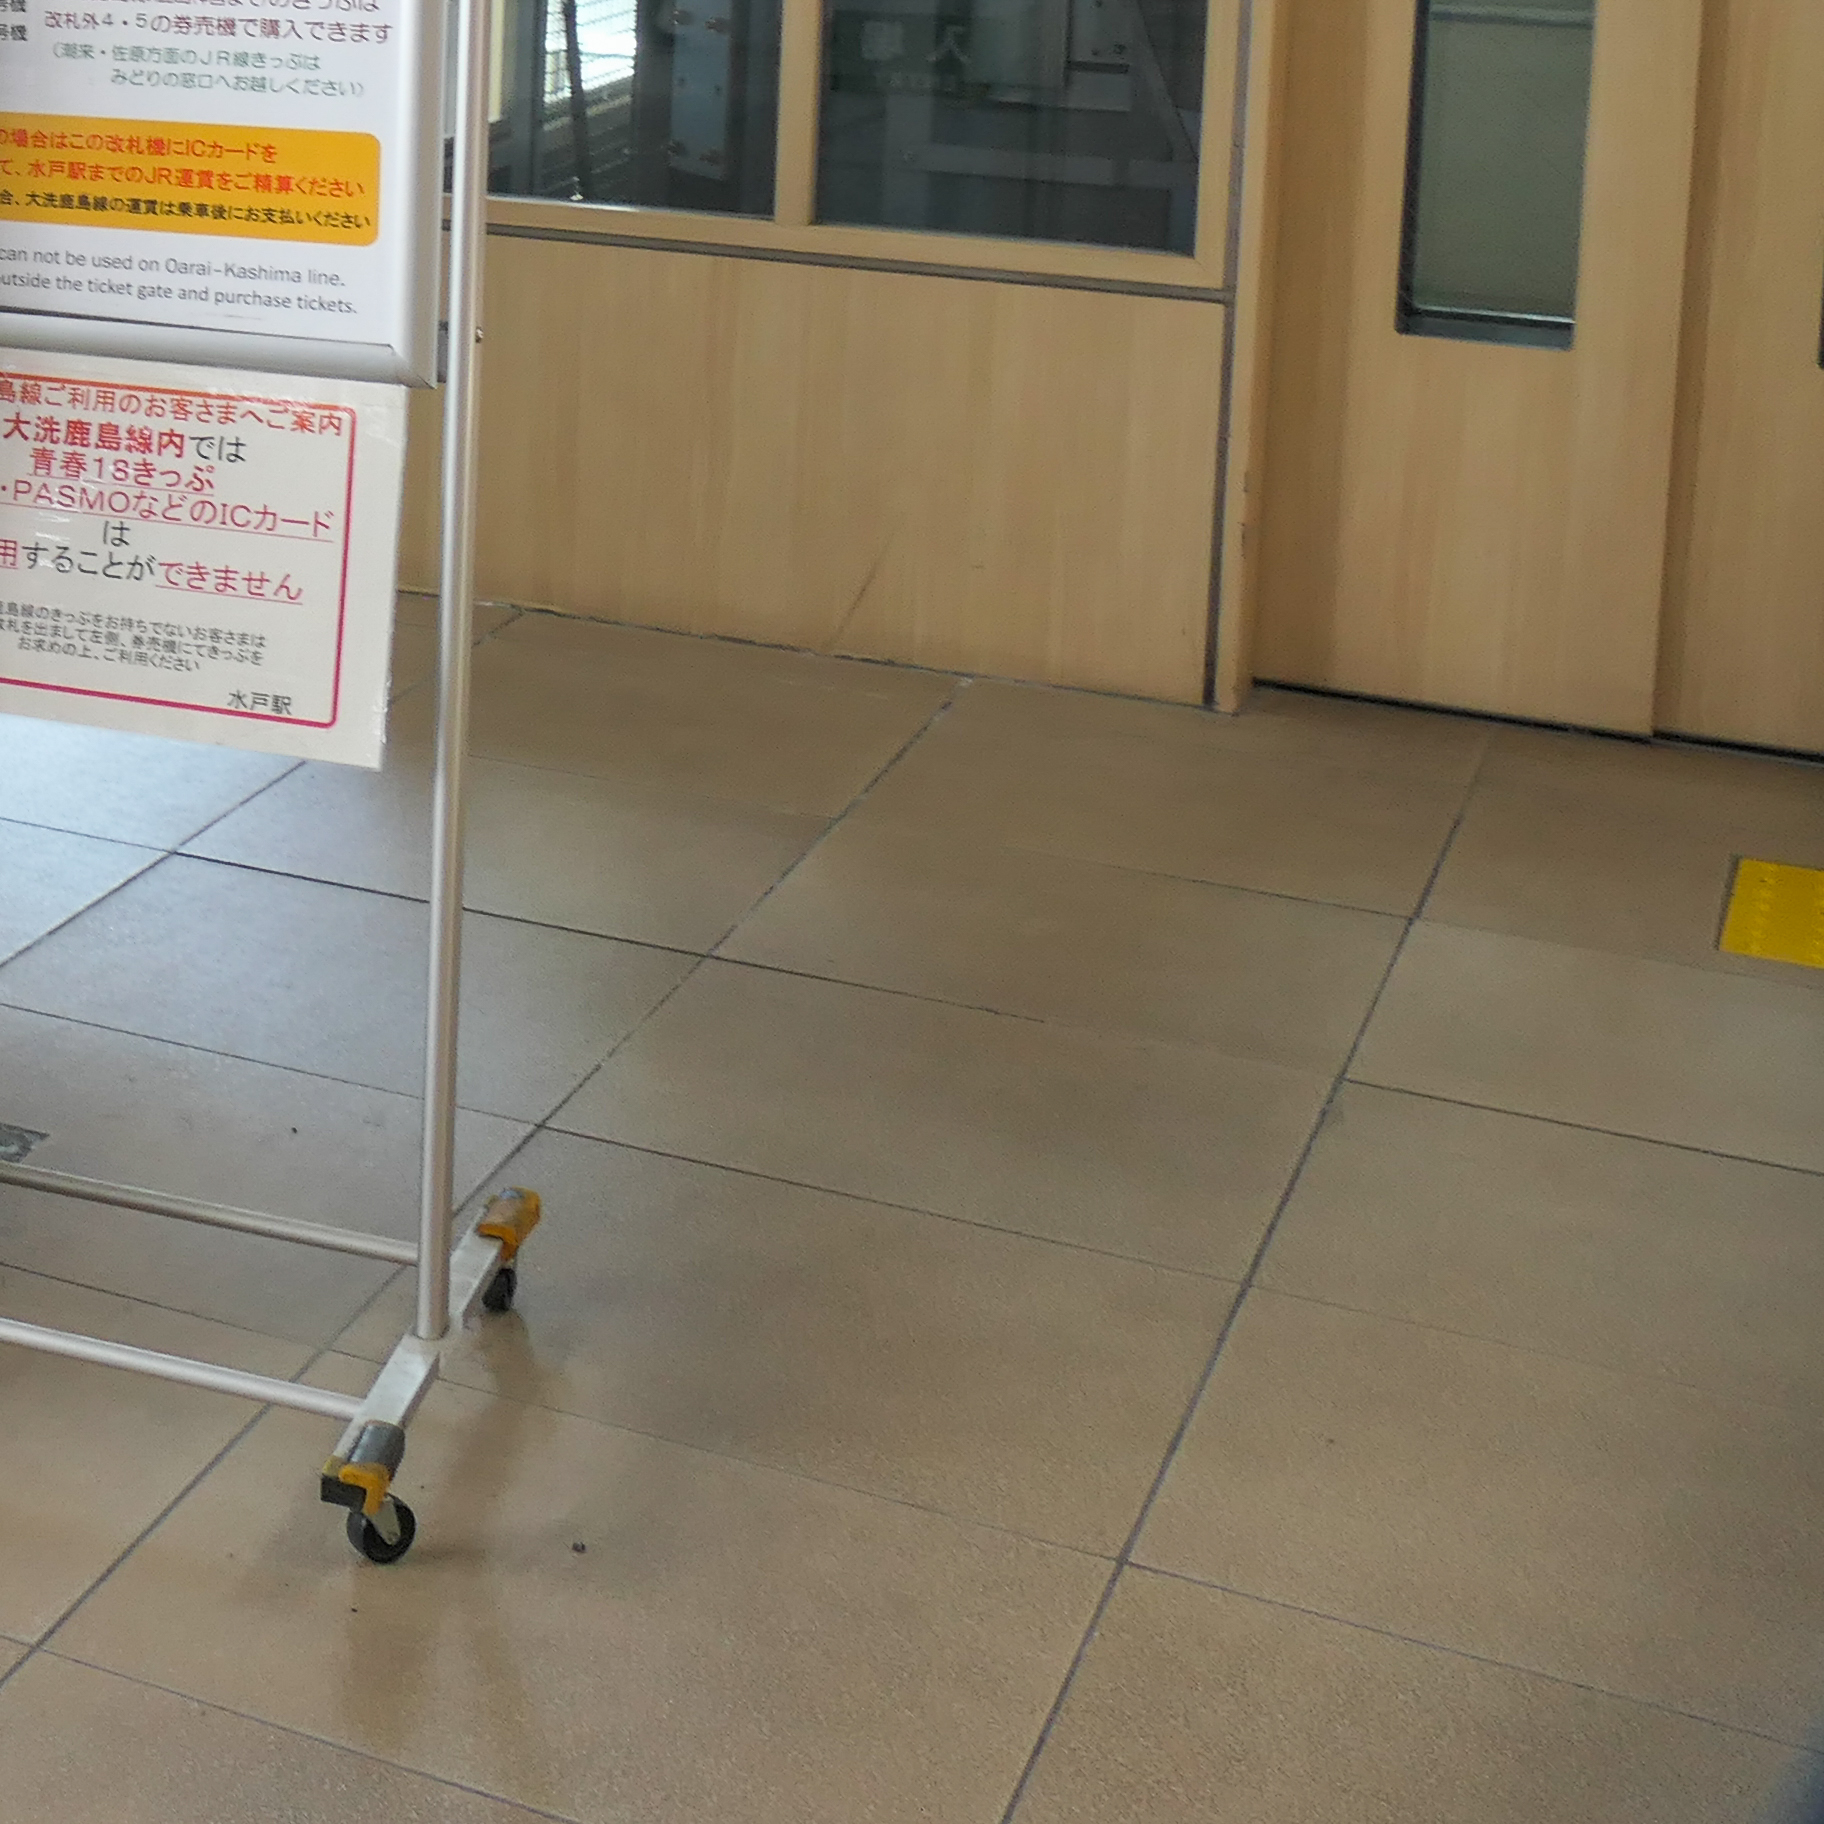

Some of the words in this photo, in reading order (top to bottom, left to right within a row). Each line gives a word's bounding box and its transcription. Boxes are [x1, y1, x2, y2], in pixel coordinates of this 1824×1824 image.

[32, 250, 61, 266] not
[65, 250, 87, 267] be
[91, 253, 133, 271] used
[137, 258, 160, 273] on
[164, 257, 302, 283] Oarai-Kashima
[308, 269, 346, 287] line.
[54, 274, 83, 293] the
[87, 278, 133, 297] ticket
[136, 283, 173, 301] gate
[177, 286, 209, 302] and
[213, 288, 292, 309] purchase
[296, 294, 359, 315] tickets.
[1, 411, 248, 464] 大洗鹿島線内では
[28, 447, 218, 493] 青春18きっぷ
[103, 520, 132, 548] は
[228, 689, 293, 716] 水戸駅
